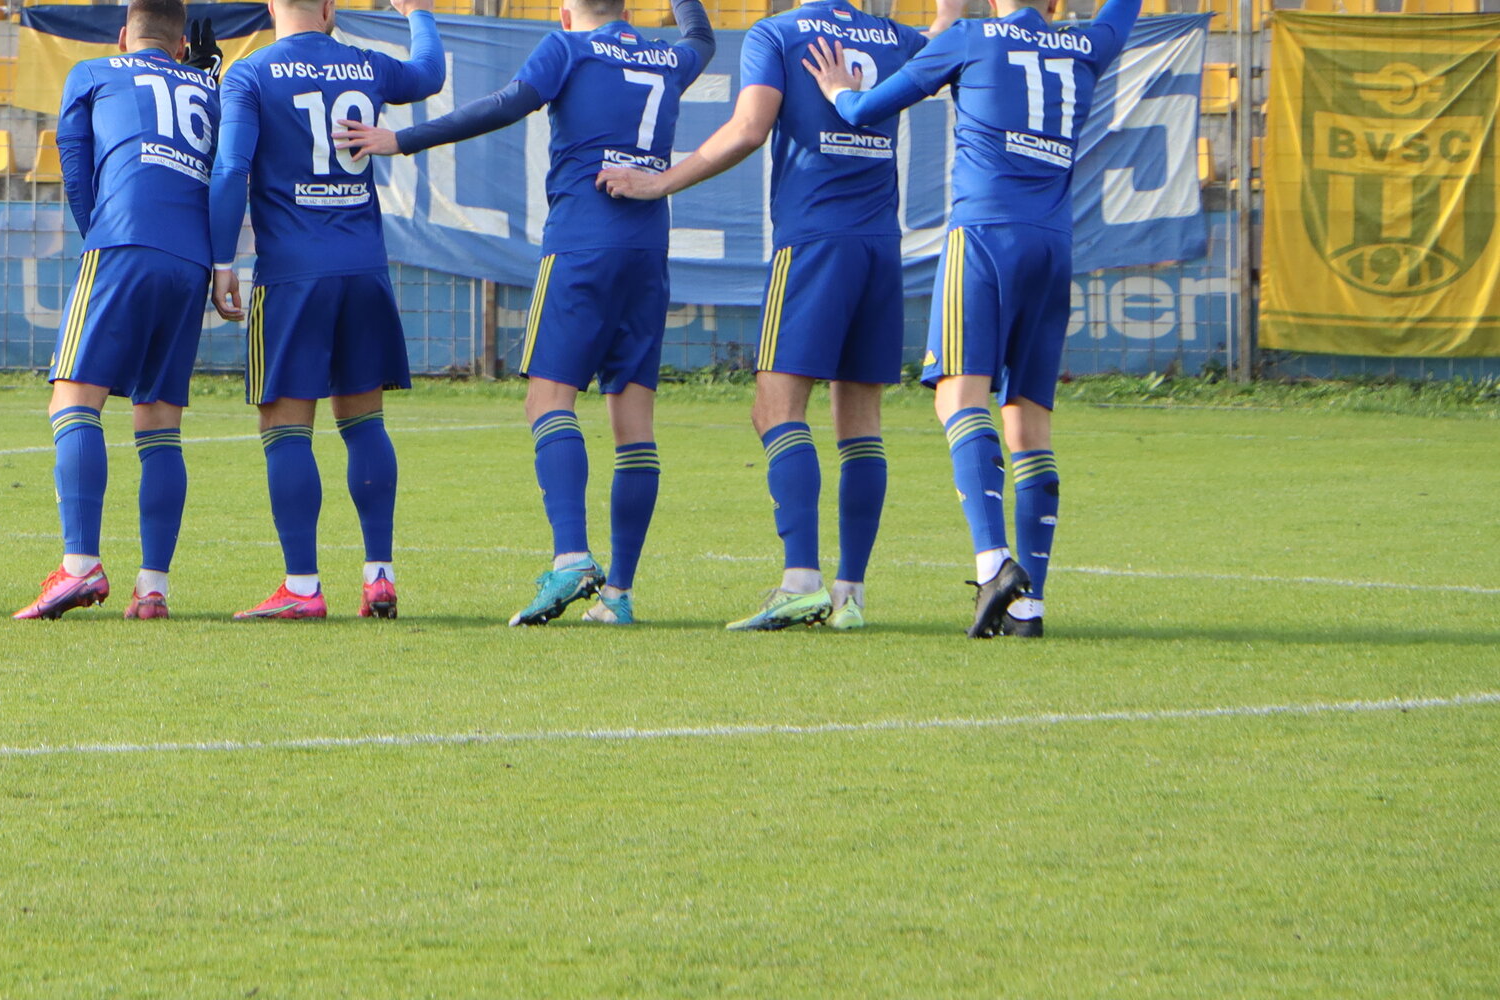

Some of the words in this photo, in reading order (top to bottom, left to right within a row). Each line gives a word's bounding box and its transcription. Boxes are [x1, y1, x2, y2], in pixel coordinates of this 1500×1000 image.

[797, 19, 898, 46] BVSC-ZUGLÓ
[984, 23, 1092, 54] BVSC-ZUGLÓ
[591, 41, 678, 68] BVSC-ZUGLÓ
[270, 60, 375, 81] BVSC-ZUGLÓ
[624, 69, 665, 151] 7
[1008, 51, 1075, 138] 11
[134, 74, 211, 155] 16
[294, 91, 375, 175] 10
[820, 131, 892, 149] KONTEX
[1328, 126, 1472, 164] BVSC
[295, 183, 368, 196] KONTEX
